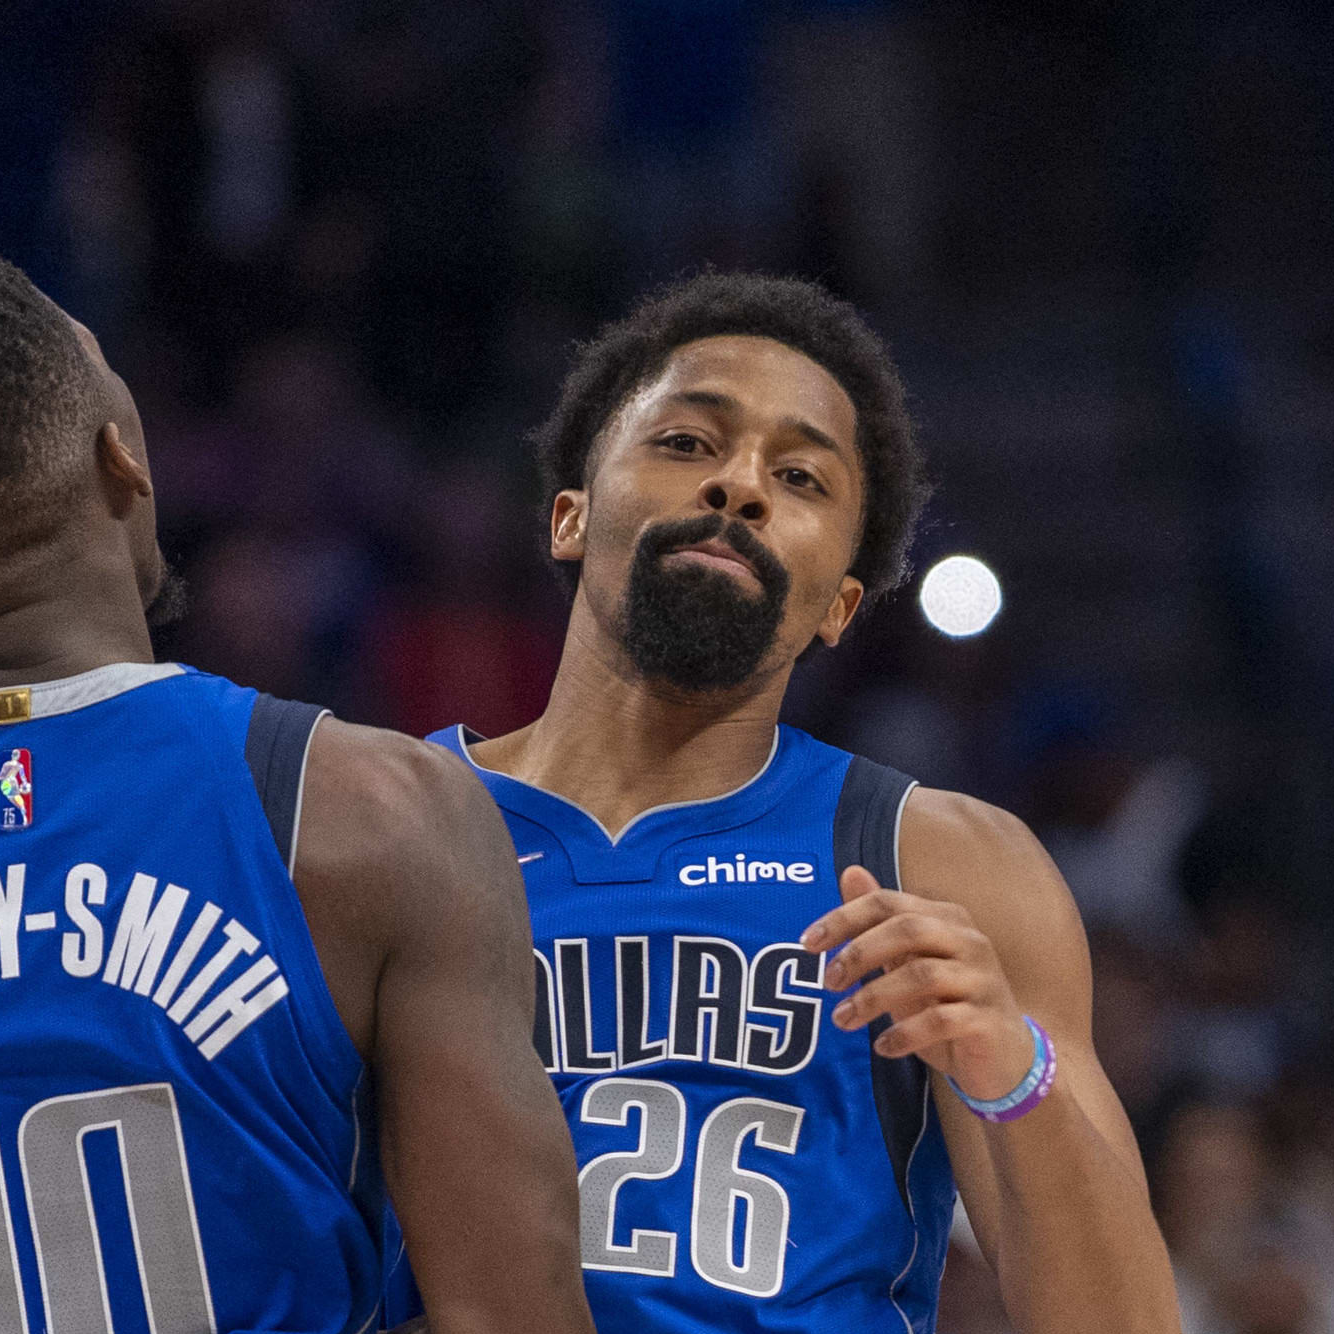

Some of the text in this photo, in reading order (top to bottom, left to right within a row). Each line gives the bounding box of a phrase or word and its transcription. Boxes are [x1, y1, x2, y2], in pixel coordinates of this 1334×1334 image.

[679, 853, 814, 886] chime
[533, 936, 825, 1074] LLAS
[578, 1077, 806, 1298] 26
